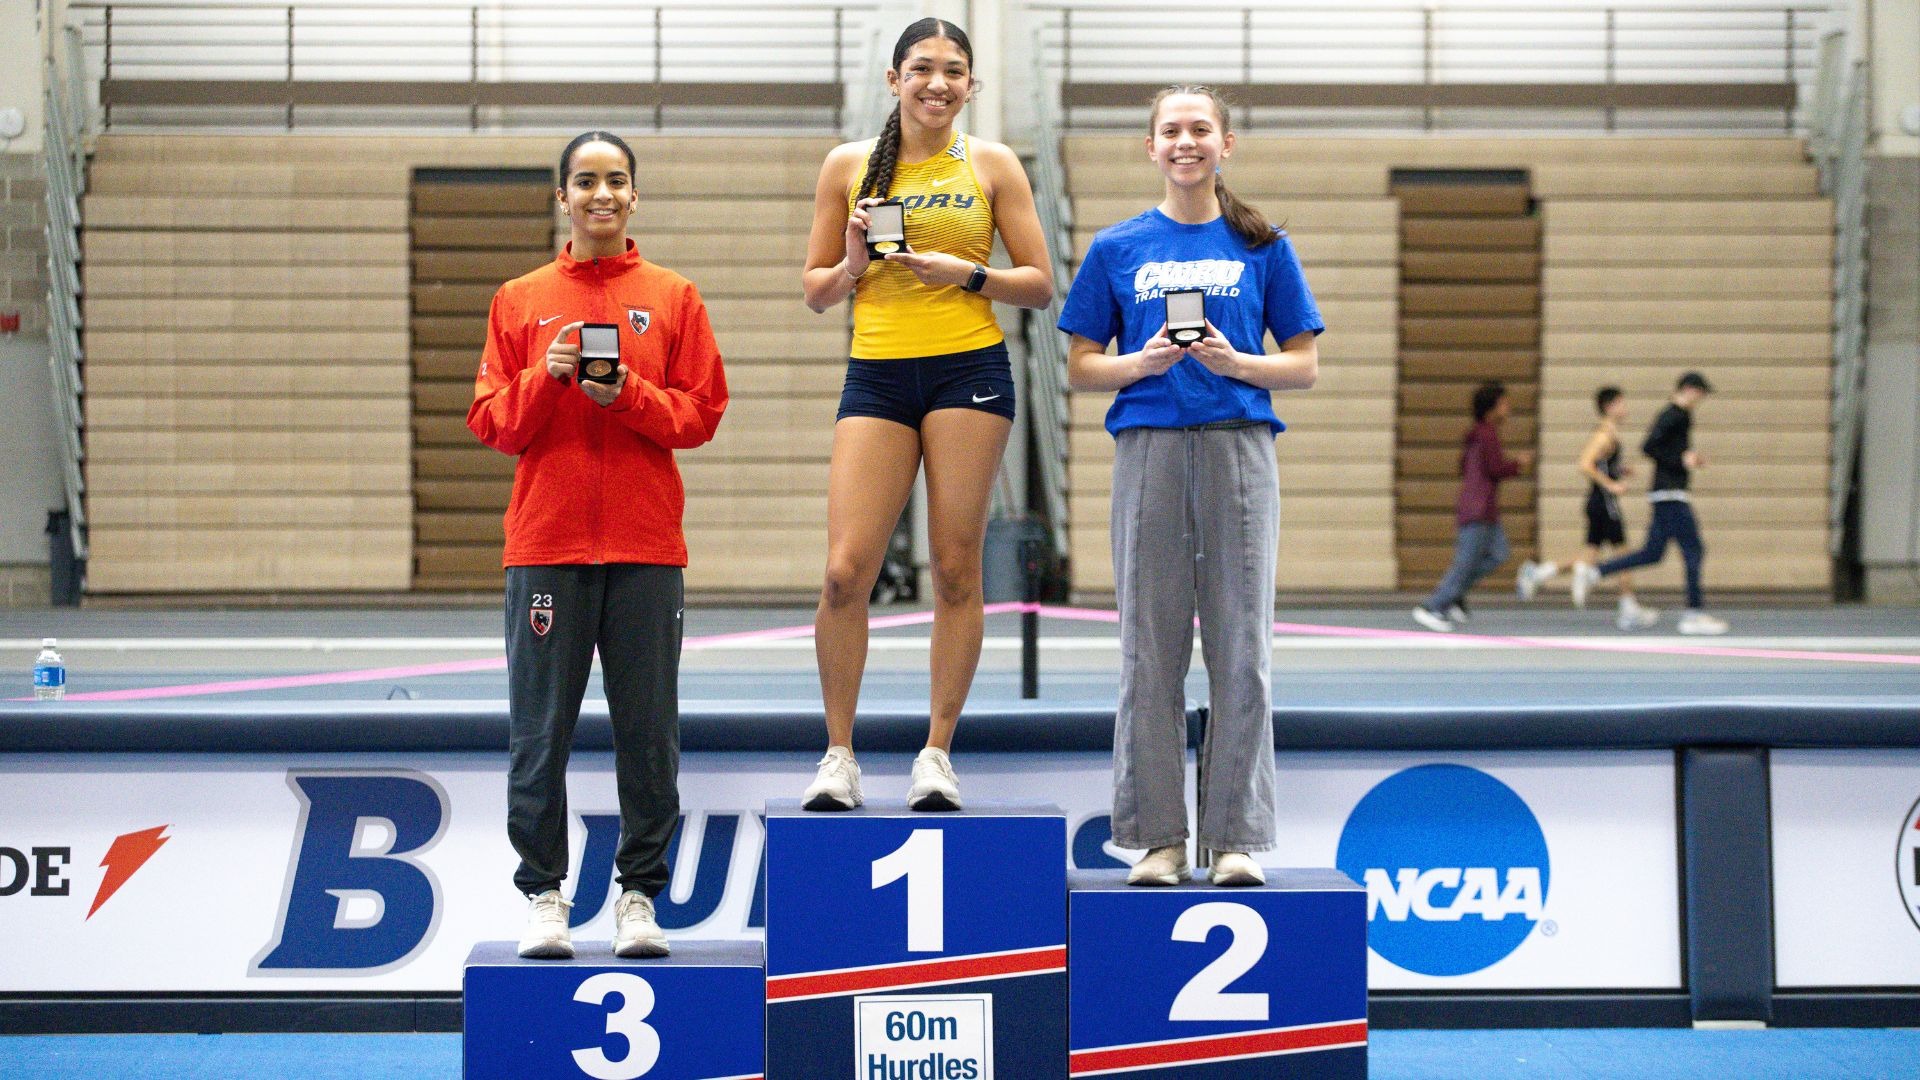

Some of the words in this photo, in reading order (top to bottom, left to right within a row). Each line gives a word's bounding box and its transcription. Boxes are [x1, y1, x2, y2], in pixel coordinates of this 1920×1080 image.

[887, 194, 975, 209] ORY
[1135, 287, 1179, 304] TRAC
[532, 593, 553, 608] 23
[247, 767, 452, 977] B
[871, 828, 944, 952] 1
[1363, 867, 1546, 922] NCAA
[1168, 901, 1270, 1021] 2
[570, 972, 661, 1080] 3
[885, 1010, 958, 1042] 60m
[868, 1052, 978, 1080] Hurdles
